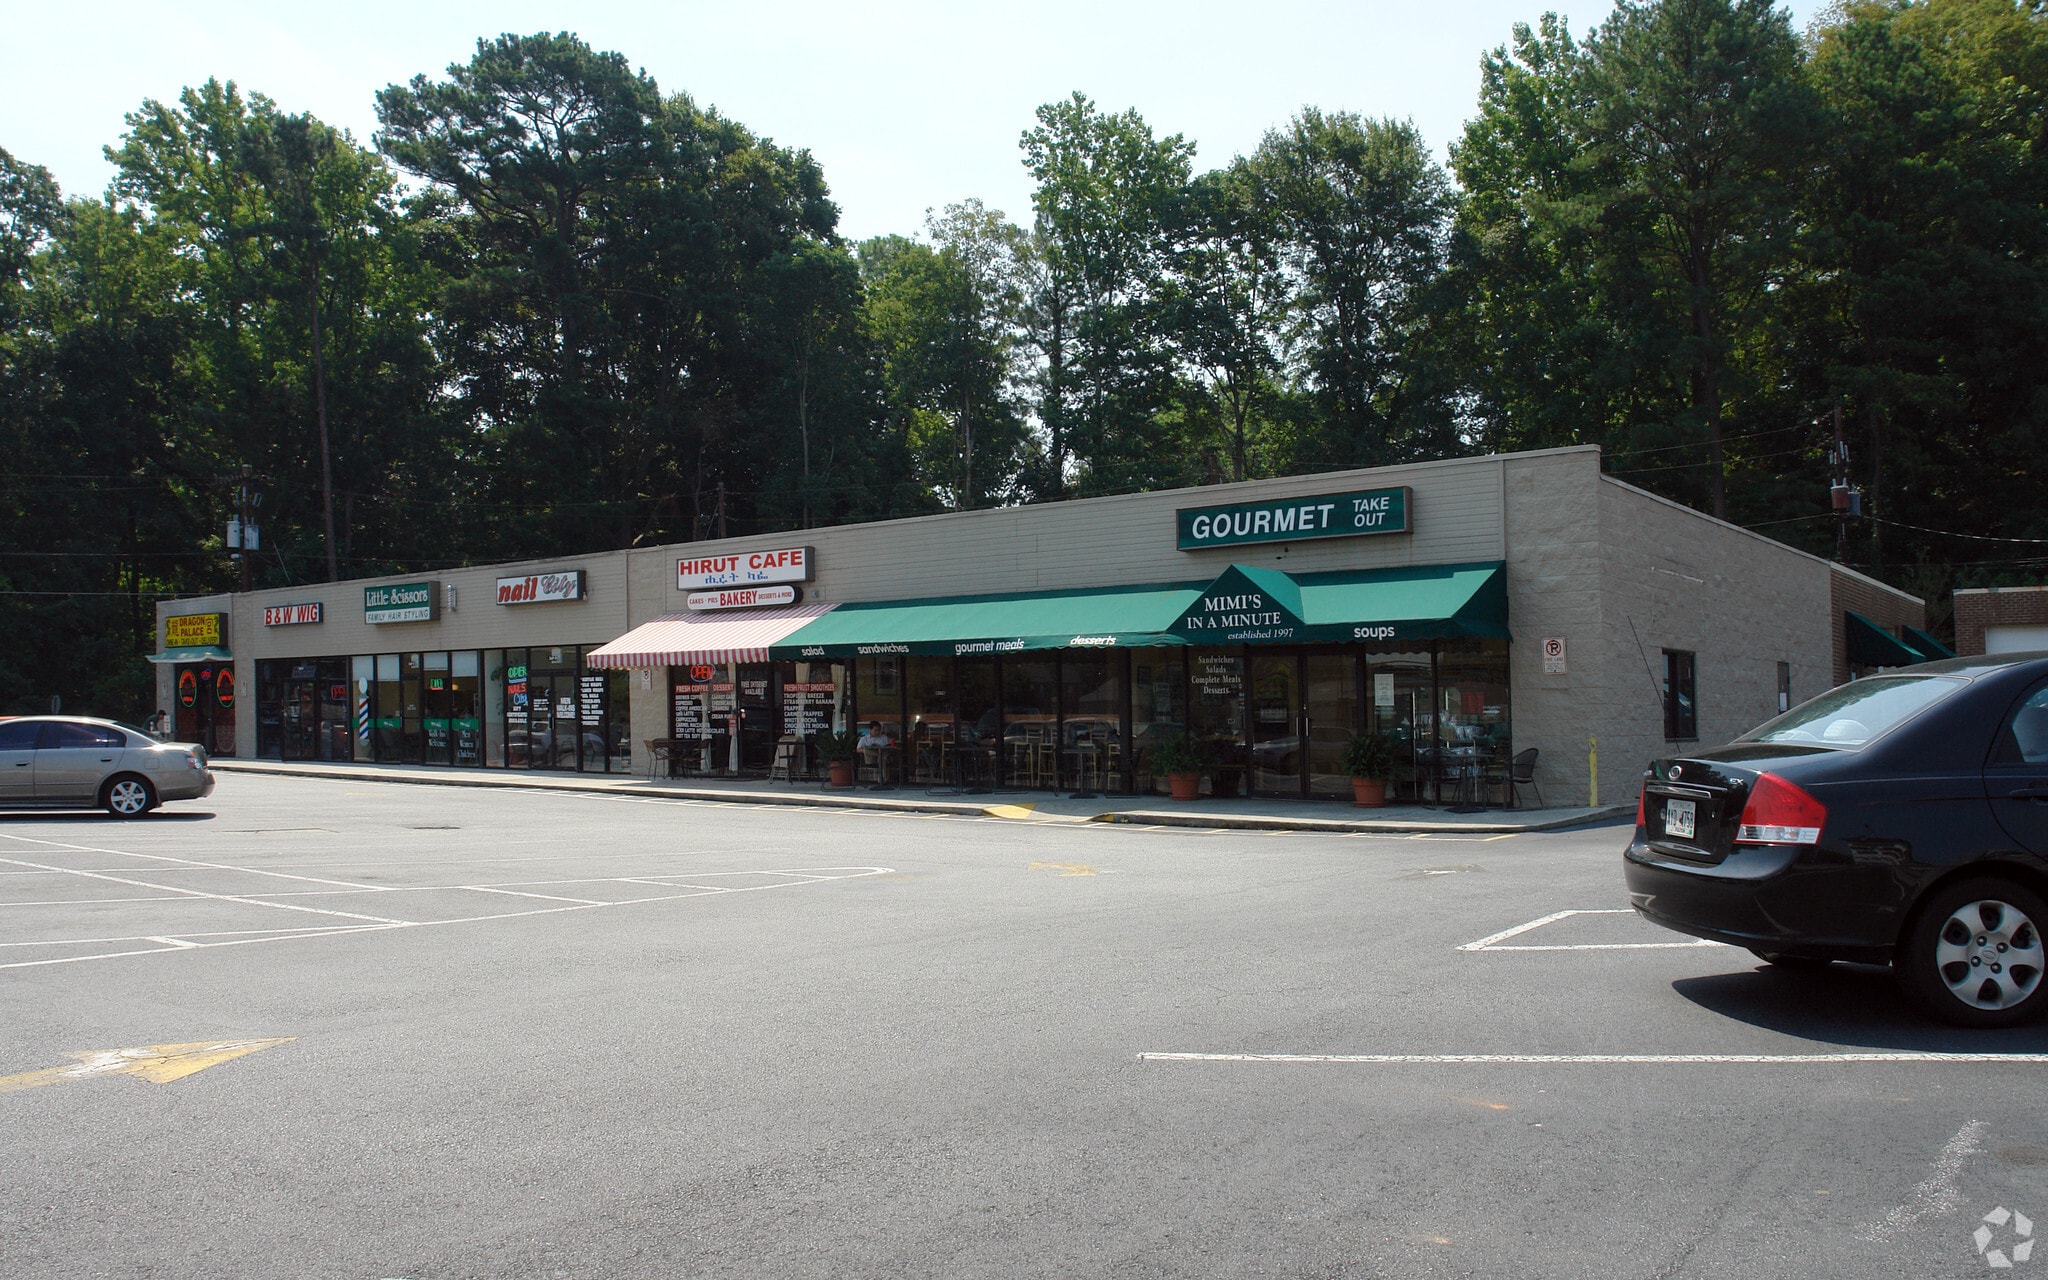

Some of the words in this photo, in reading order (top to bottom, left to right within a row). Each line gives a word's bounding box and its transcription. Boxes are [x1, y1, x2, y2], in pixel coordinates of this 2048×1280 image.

[1192, 504, 1335, 539] GOURMET
[1353, 497, 1390, 513] TAKE
[1354, 512, 1386, 527] OUT
[680, 557, 739, 575] HIRUT
[748, 550, 803, 569] CAFE
[498, 577, 538, 602] nail
[541, 575, 576, 598] City
[366, 590, 389, 606] Little
[391, 588, 428, 605] Scissors
[720, 590, 758, 606] BAKERY
[1204, 594, 1262, 612] MIMI'S
[297, 604, 318, 621] WIG
[368, 612, 386, 622] FAMILY
[388, 610, 402, 620] HAIR
[404, 608, 428, 619] STYLING
[180, 616, 206, 627] DRAGON
[1187, 616, 1203, 629] IN
[1207, 616, 1218, 628] A
[1221, 612, 1281, 627] MINUTE
[181, 627, 204, 636] PALACE
[1228, 629, 1271, 640] established
[1274, 628, 1294, 639] 1997
[1354, 626, 1395, 640] soups
[955, 640, 994, 656] gourmet
[996, 638, 1024, 650] meals
[1070, 635, 1116, 646] desserts
[802, 646, 825, 656] salad
[858, 643, 909, 655] sandwiches
[691, 665, 713, 679] OPEN
[1191, 676, 1220, 685] Complete
